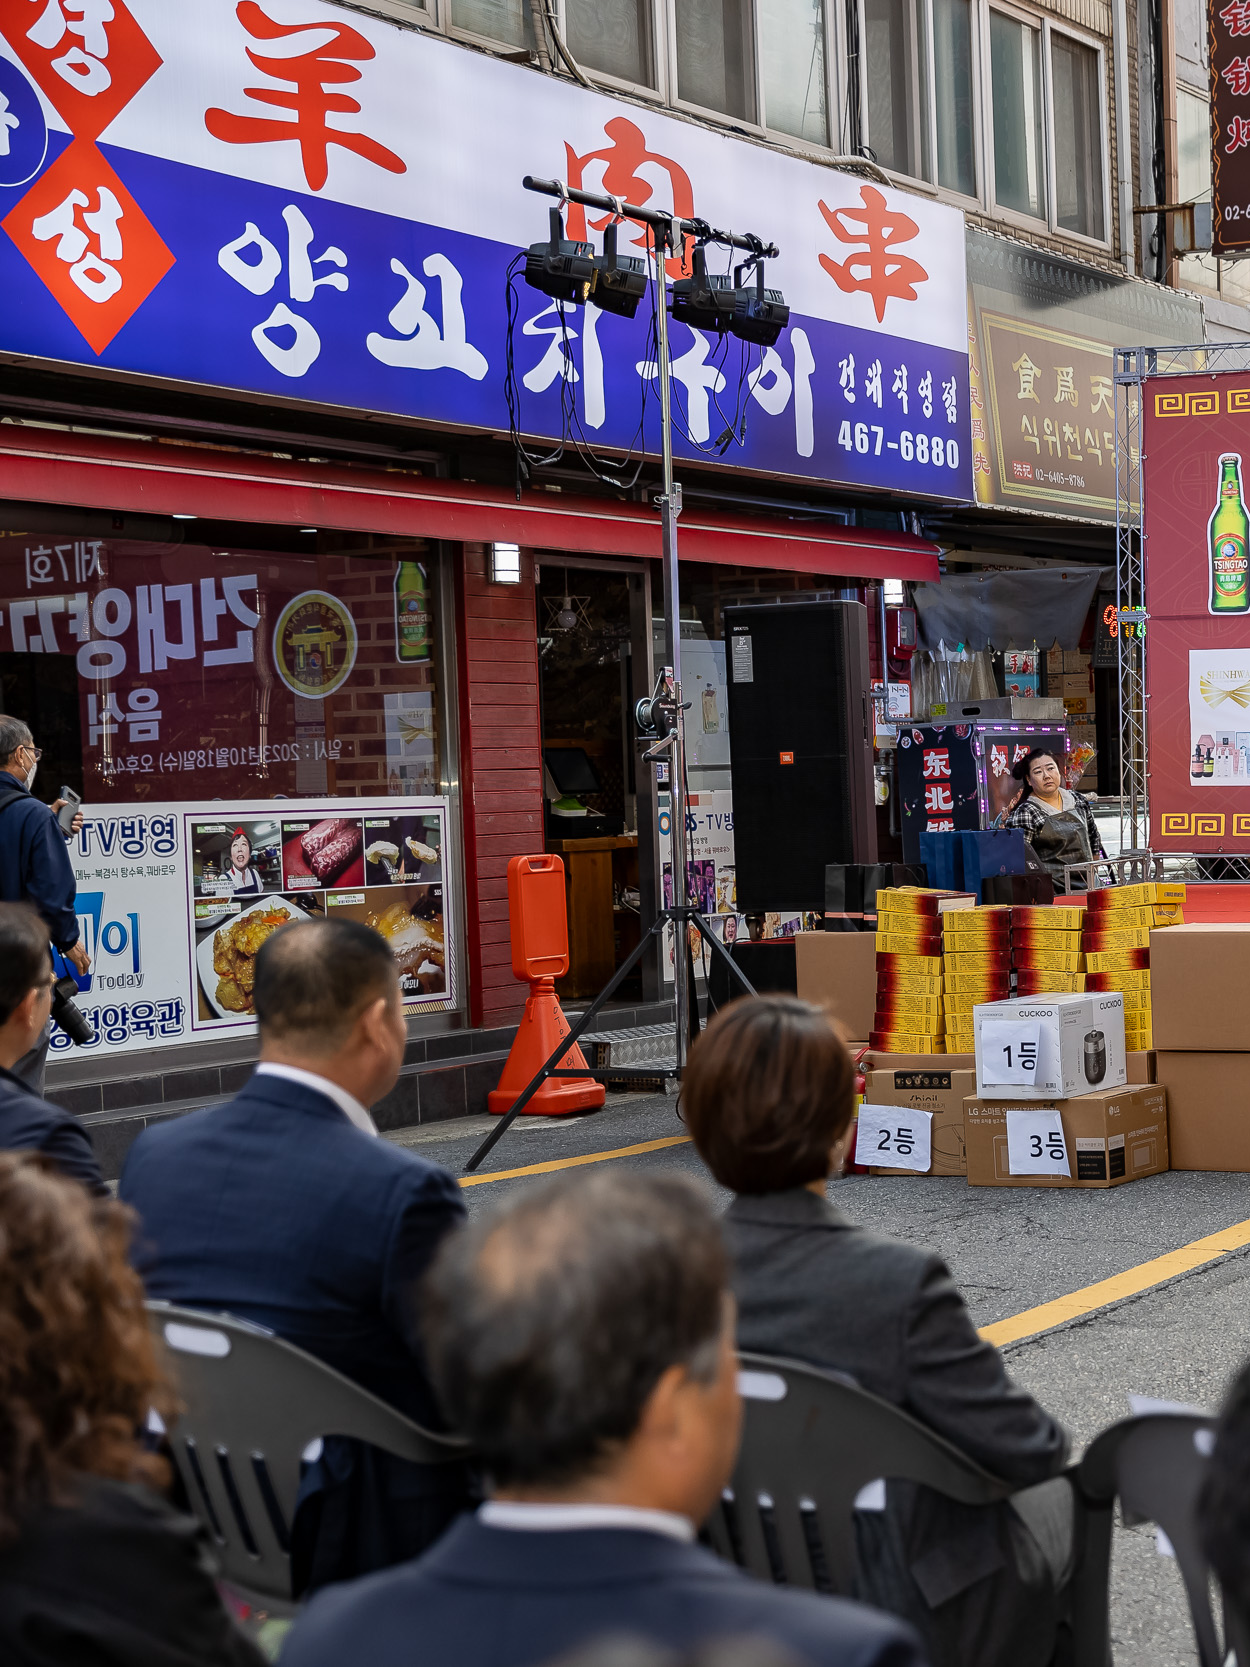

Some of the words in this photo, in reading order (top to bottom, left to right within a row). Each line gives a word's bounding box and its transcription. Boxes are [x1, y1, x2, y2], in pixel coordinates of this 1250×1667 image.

[217, 203, 816, 458] 양꼬치구이
[838, 420, 960, 470] 467-6880
[1035, 467, 1085, 488] 02-6405-8786
[1214, 559, 1248, 570] TSINGTAO
[98, 973, 143, 990] Today
[1018, 1010, 1053, 1018] CUCKOO
[1100, 999, 1123, 1011] CUCKOO
[1002, 1042, 1037, 1071] 1등
[968, 1108, 979, 1116] LG
[981, 1108, 1002, 1116] 스마트
[877, 1127, 916, 1155] 2등
[1029, 1131, 1065, 1161] 3등
